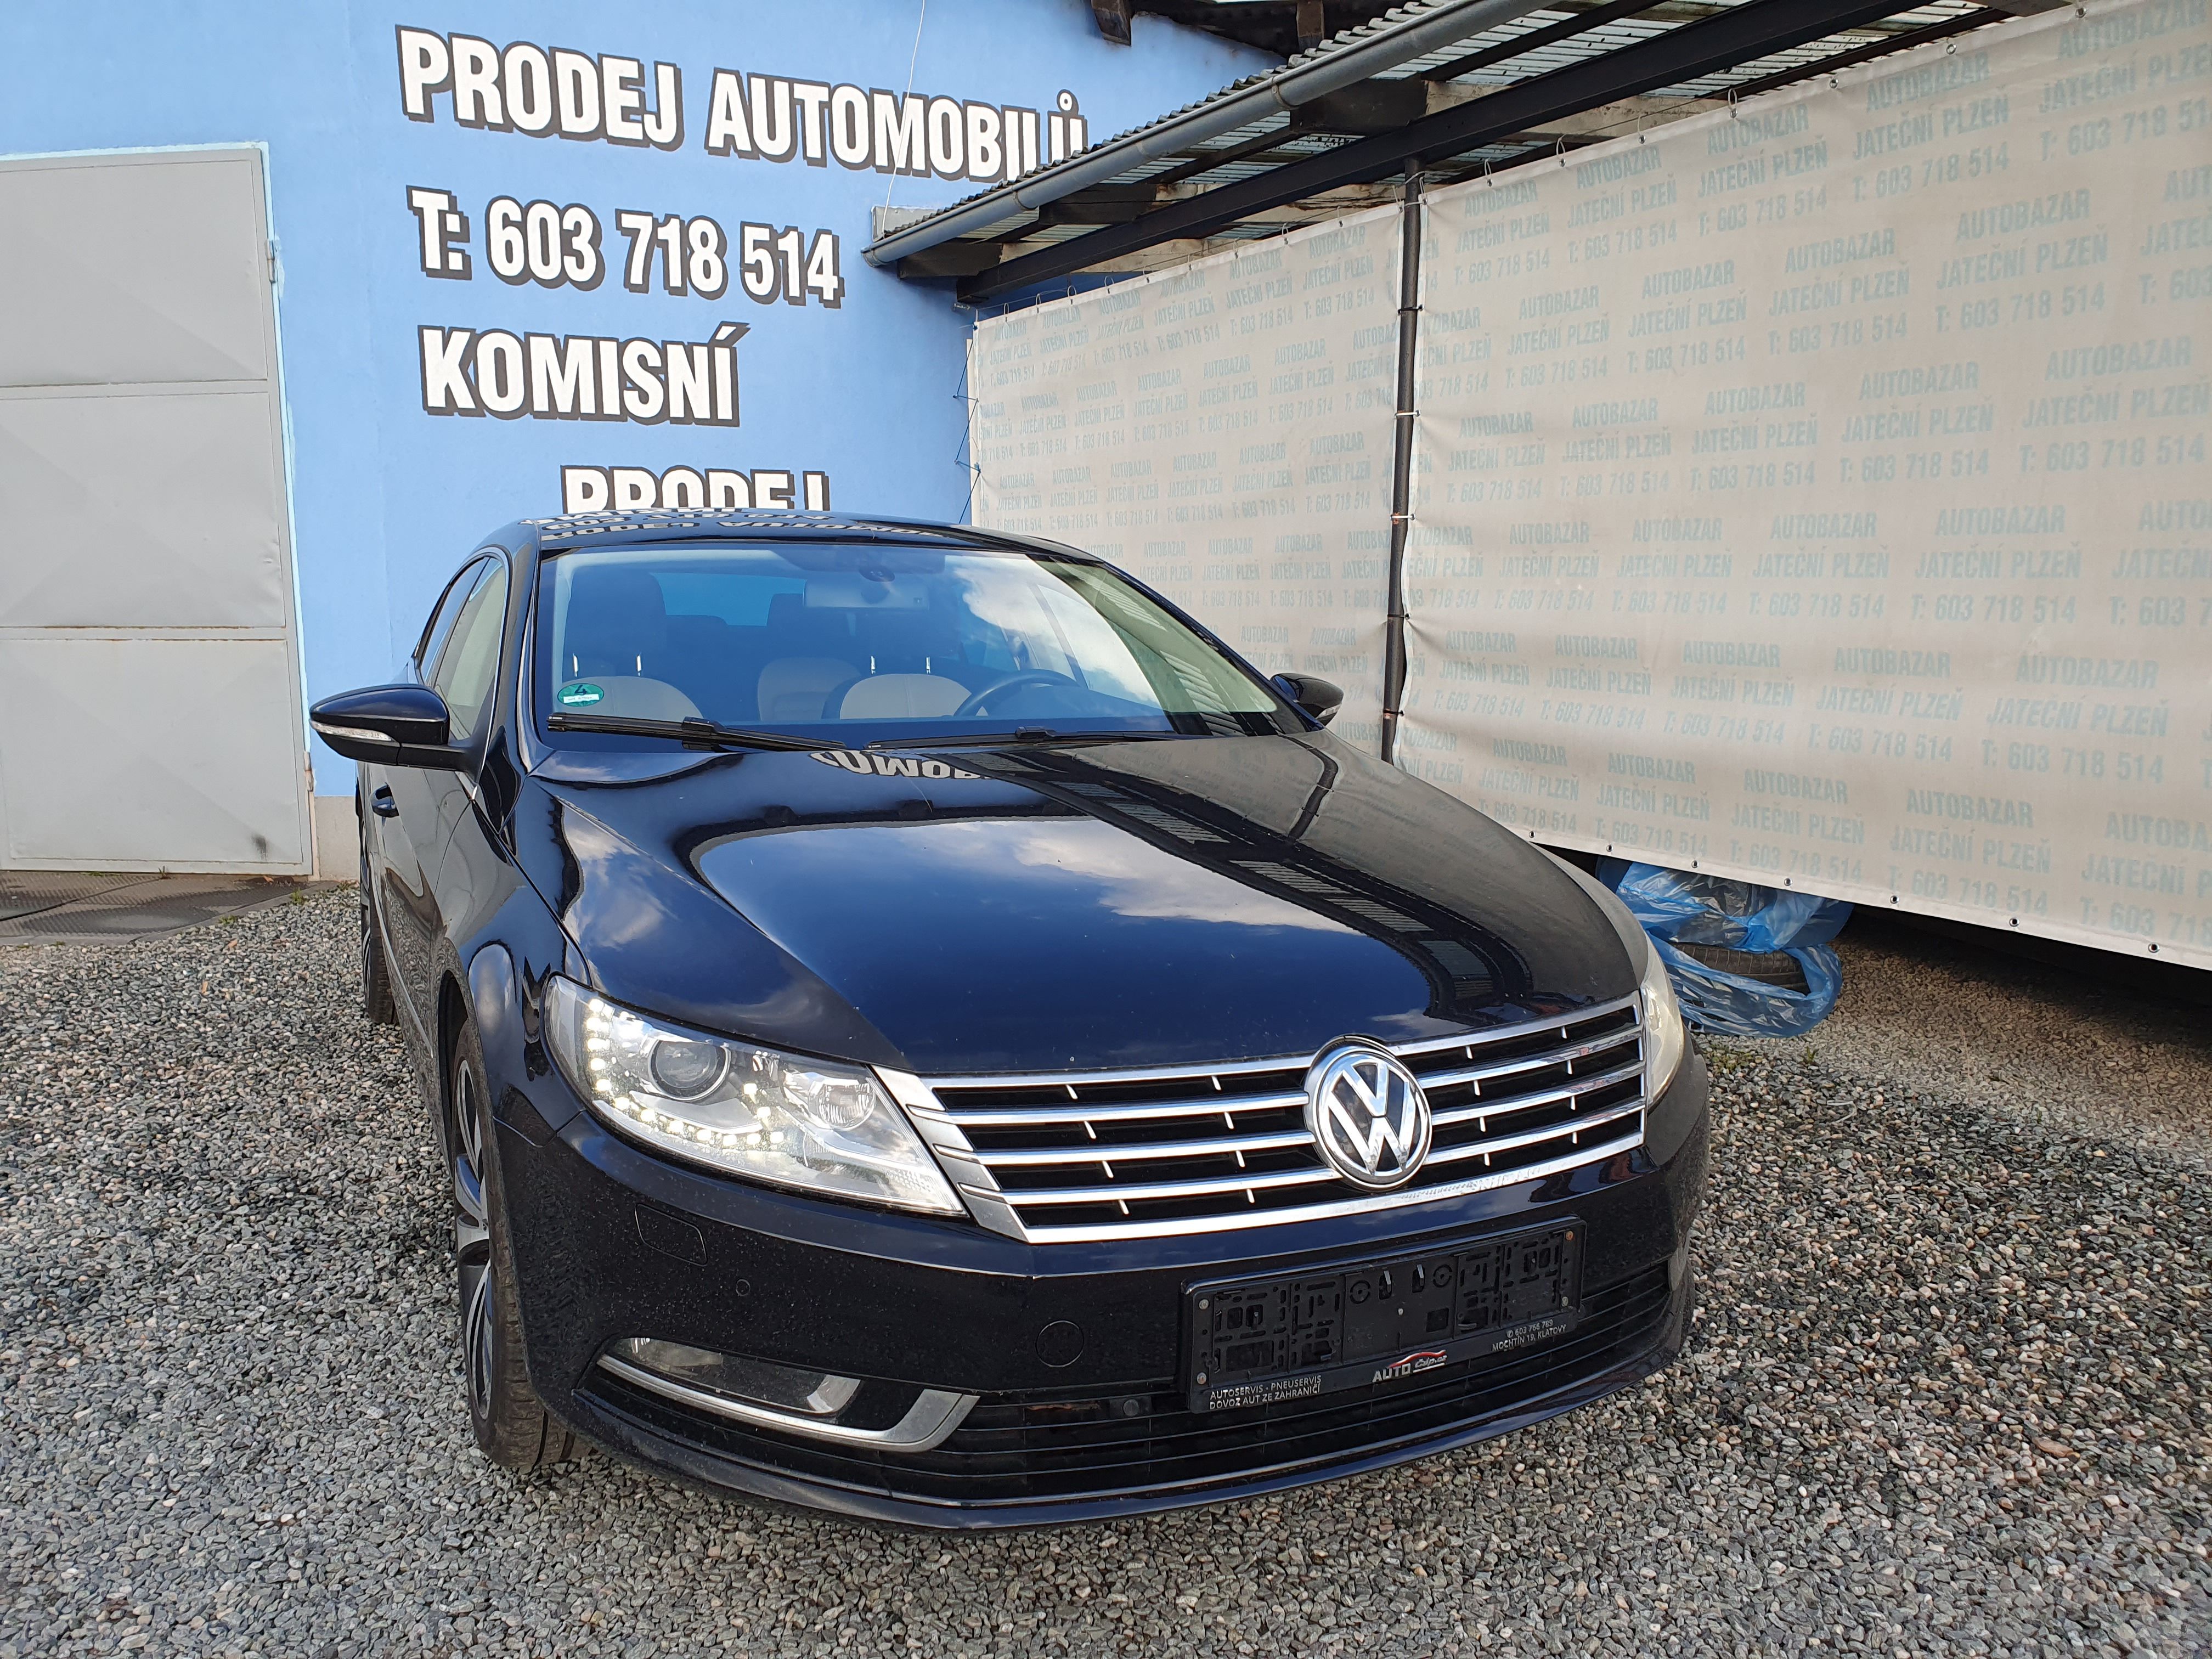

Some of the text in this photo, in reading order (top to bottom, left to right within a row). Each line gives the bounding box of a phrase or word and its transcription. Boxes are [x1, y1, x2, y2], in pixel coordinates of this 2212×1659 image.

[1867, 52, 1988, 110] AUTOBAZAR
[395, 25, 1088, 183] PRODEJ AUTOMOBILŮ
[1708, 103, 1808, 154] AUTOBAZAR
[1577, 145, 1660, 187] AUTOBAZAR
[1876, 165, 1912, 198] 603
[1923, 154, 1960, 186] 718
[1968, 143, 2010, 178] 514
[1717, 204, 1747, 232] 603
[1756, 194, 1787, 224] 718
[1794, 186, 1827, 218] 514
[1957, 189, 2090, 241] AUTOBAZAR
[406, 185, 845, 309] T: 603 718 514
[1584, 234, 1610, 261] 603
[1616, 225, 1643, 253] 718
[1649, 219, 1677, 248] 514
[1785, 228, 1895, 272] AUTOBAZAR
[1643, 259, 1734, 297] AUTOBAZAR
[1960, 298, 1999, 330] 603
[2012, 289, 2052, 321] 718
[2062, 283, 2105, 317] 514
[1788, 325, 1821, 353] 603
[1831, 319, 1863, 347] 718
[1872, 312, 1907, 343] 514
[1645, 346, 1673, 372] 603
[1680, 341, 1708, 366] 718
[1714, 336, 1746, 364] 514
[2046, 337, 2192, 380] AUTOBAZAR
[417, 321, 751, 427] KOMISNÍ
[1860, 362, 1979, 399] AUTOBAZAR
[1705, 381, 1805, 415] AUTOBAZAR
[1861, 455, 1895, 483] 603
[1906, 452, 1942, 479] 718
[1951, 449, 1989, 478] 514
[2046, 441, 2089, 472] 603
[2102, 437, 2146, 469] 718
[2156, 435, 2205, 466] 514
[1708, 466, 1738, 491] 603
[1747, 462, 1776, 489] 718
[1782, 460, 1815, 487] 514
[1771, 512, 1877, 539] AUTOBAZAR
[1936, 505, 2065, 535] AUTOBAZAR
[1768, 592, 1801, 617] 603
[1809, 592, 1842, 618] 718
[1848, 594, 1884, 619] 514
[1934, 595, 1973, 622] 603
[1984, 595, 2024, 623] 718
[2033, 595, 2076, 624] 514
[1683, 642, 1780, 668] AUTOBAZAR
[1834, 648, 1950, 677] AUTOBAZAR
[2016, 655, 2156, 688] AUTOBAZAR
[574, 684, 588, 695] 4
[1680, 713, 1711, 737] 603
[1717, 715, 1748, 742] 718
[1752, 719, 1785, 744] 514
[1827, 726, 1863, 754] 603
[1871, 730, 1906, 758] 718
[1914, 733, 1952, 762] 514
[2007, 742, 2049, 772] 603
[2063, 747, 2106, 780] 718
[2117, 752, 2164, 785] 514
[1907, 790, 2033, 826] AUTOBAZAR
[1910, 868, 1949, 898] 603
[1958, 876, 1999, 907] 718
[2006, 884, 2049, 915] 514
[1515, 1327, 1527, 1336] 603
[1538, 1324, 1566, 1339] KLATOVY
[1210, 1385, 1263, 1400] AUTOSERVIS
[1271, 1375, 1322, 1391] PNEUSERVIS
[1373, 1363, 1412, 1383] AUTO
[1210, 1398, 1241, 1410] DOVOZ
[1243, 1395, 1261, 1406] AUT
[1262, 1392, 1273, 1402] ZE
